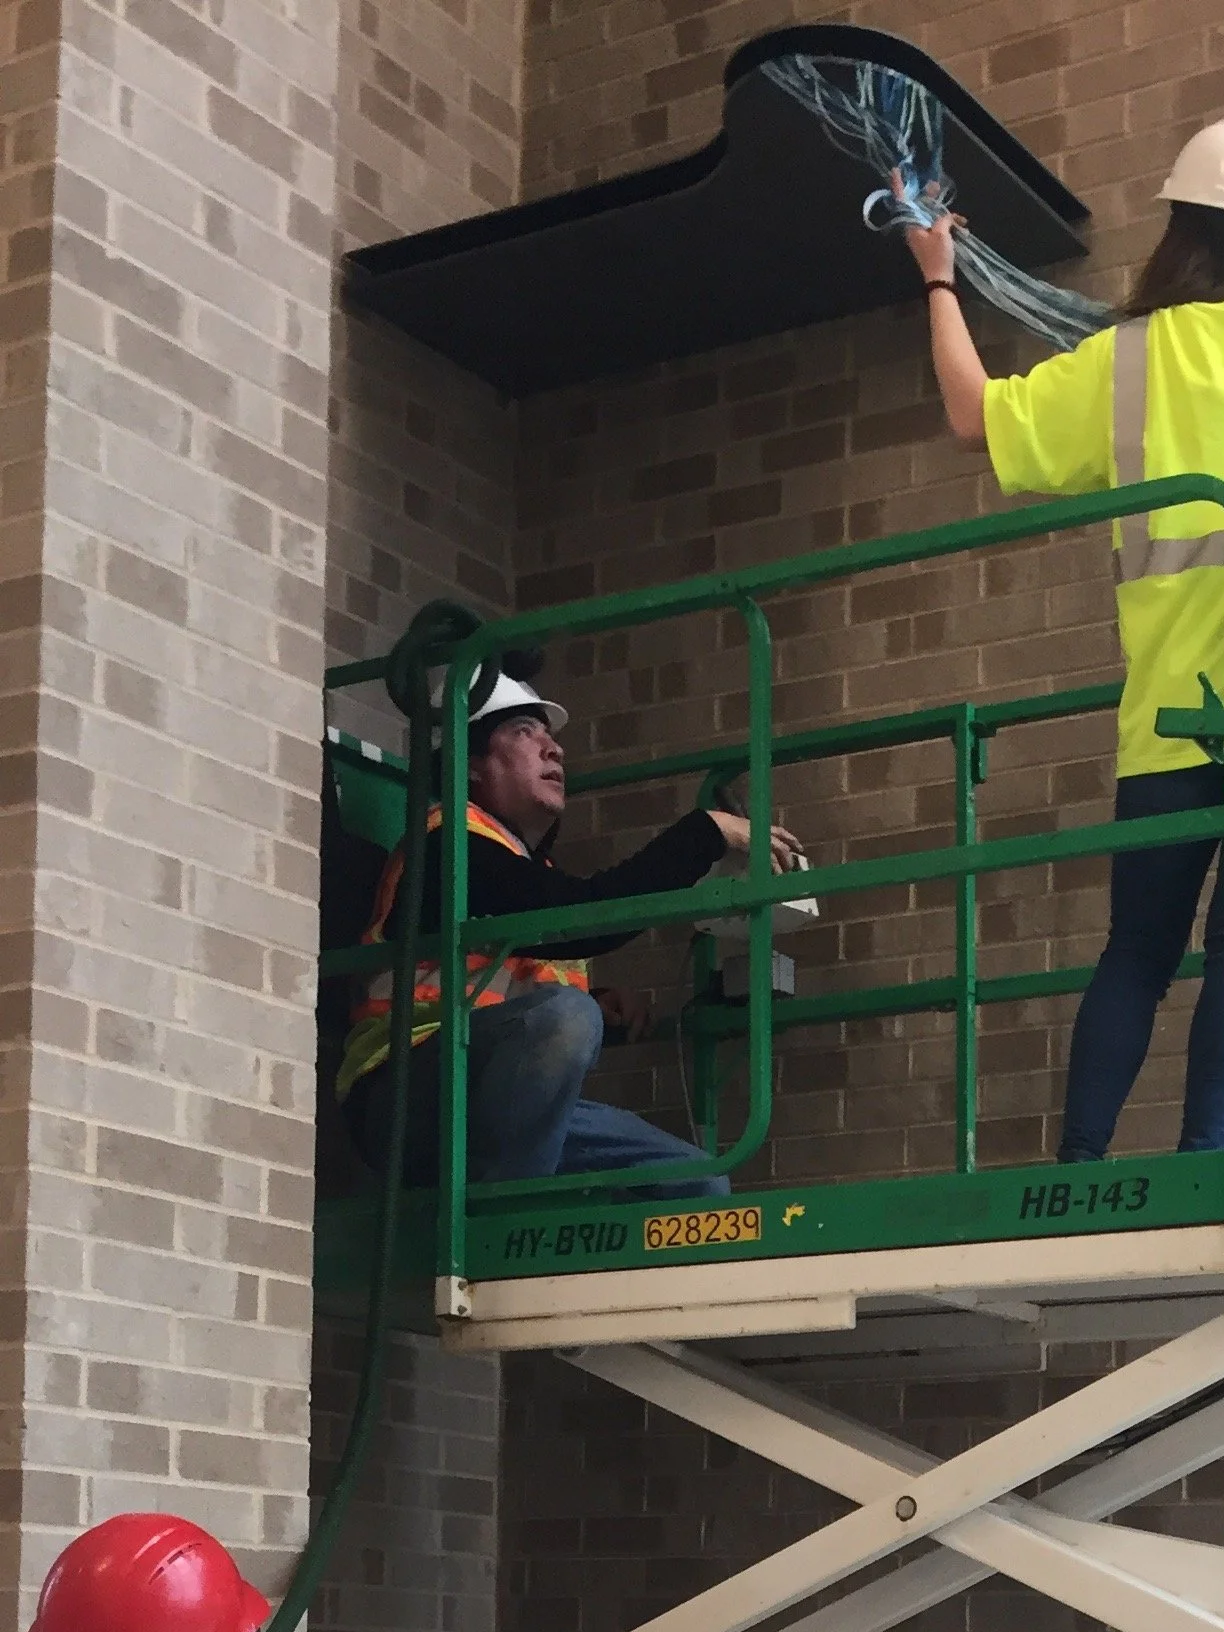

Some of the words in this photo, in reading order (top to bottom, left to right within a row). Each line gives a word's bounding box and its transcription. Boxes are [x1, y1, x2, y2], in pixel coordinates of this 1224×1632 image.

[1018, 1177, 1150, 1220] HB-143
[504, 1222, 629, 1260] HY-BRID
[646, 1208, 760, 1249] 628239
